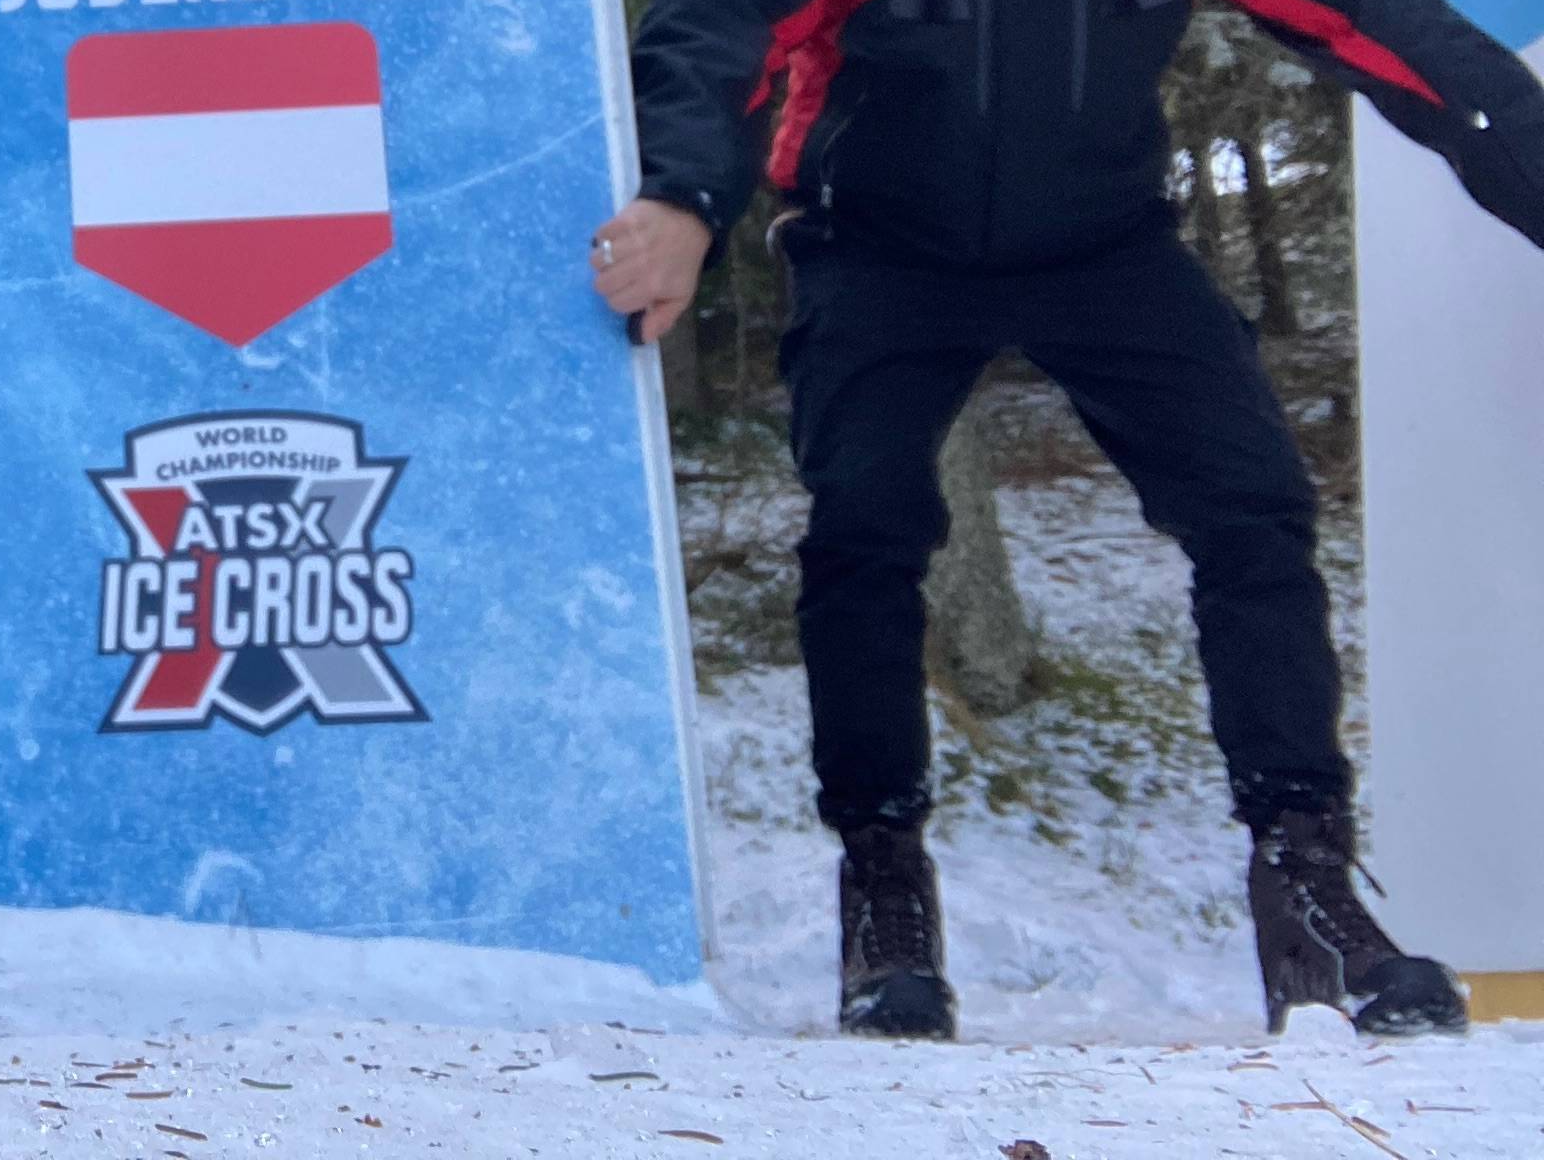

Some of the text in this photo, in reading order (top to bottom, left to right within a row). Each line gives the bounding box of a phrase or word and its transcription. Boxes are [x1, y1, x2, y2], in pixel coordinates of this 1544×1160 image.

[195, 425, 288, 449] WORLD
[156, 450, 342, 482] CHAMPIONSHIP
[173, 499, 333, 552] ATSX
[101, 550, 413, 654] ICE CROSS
